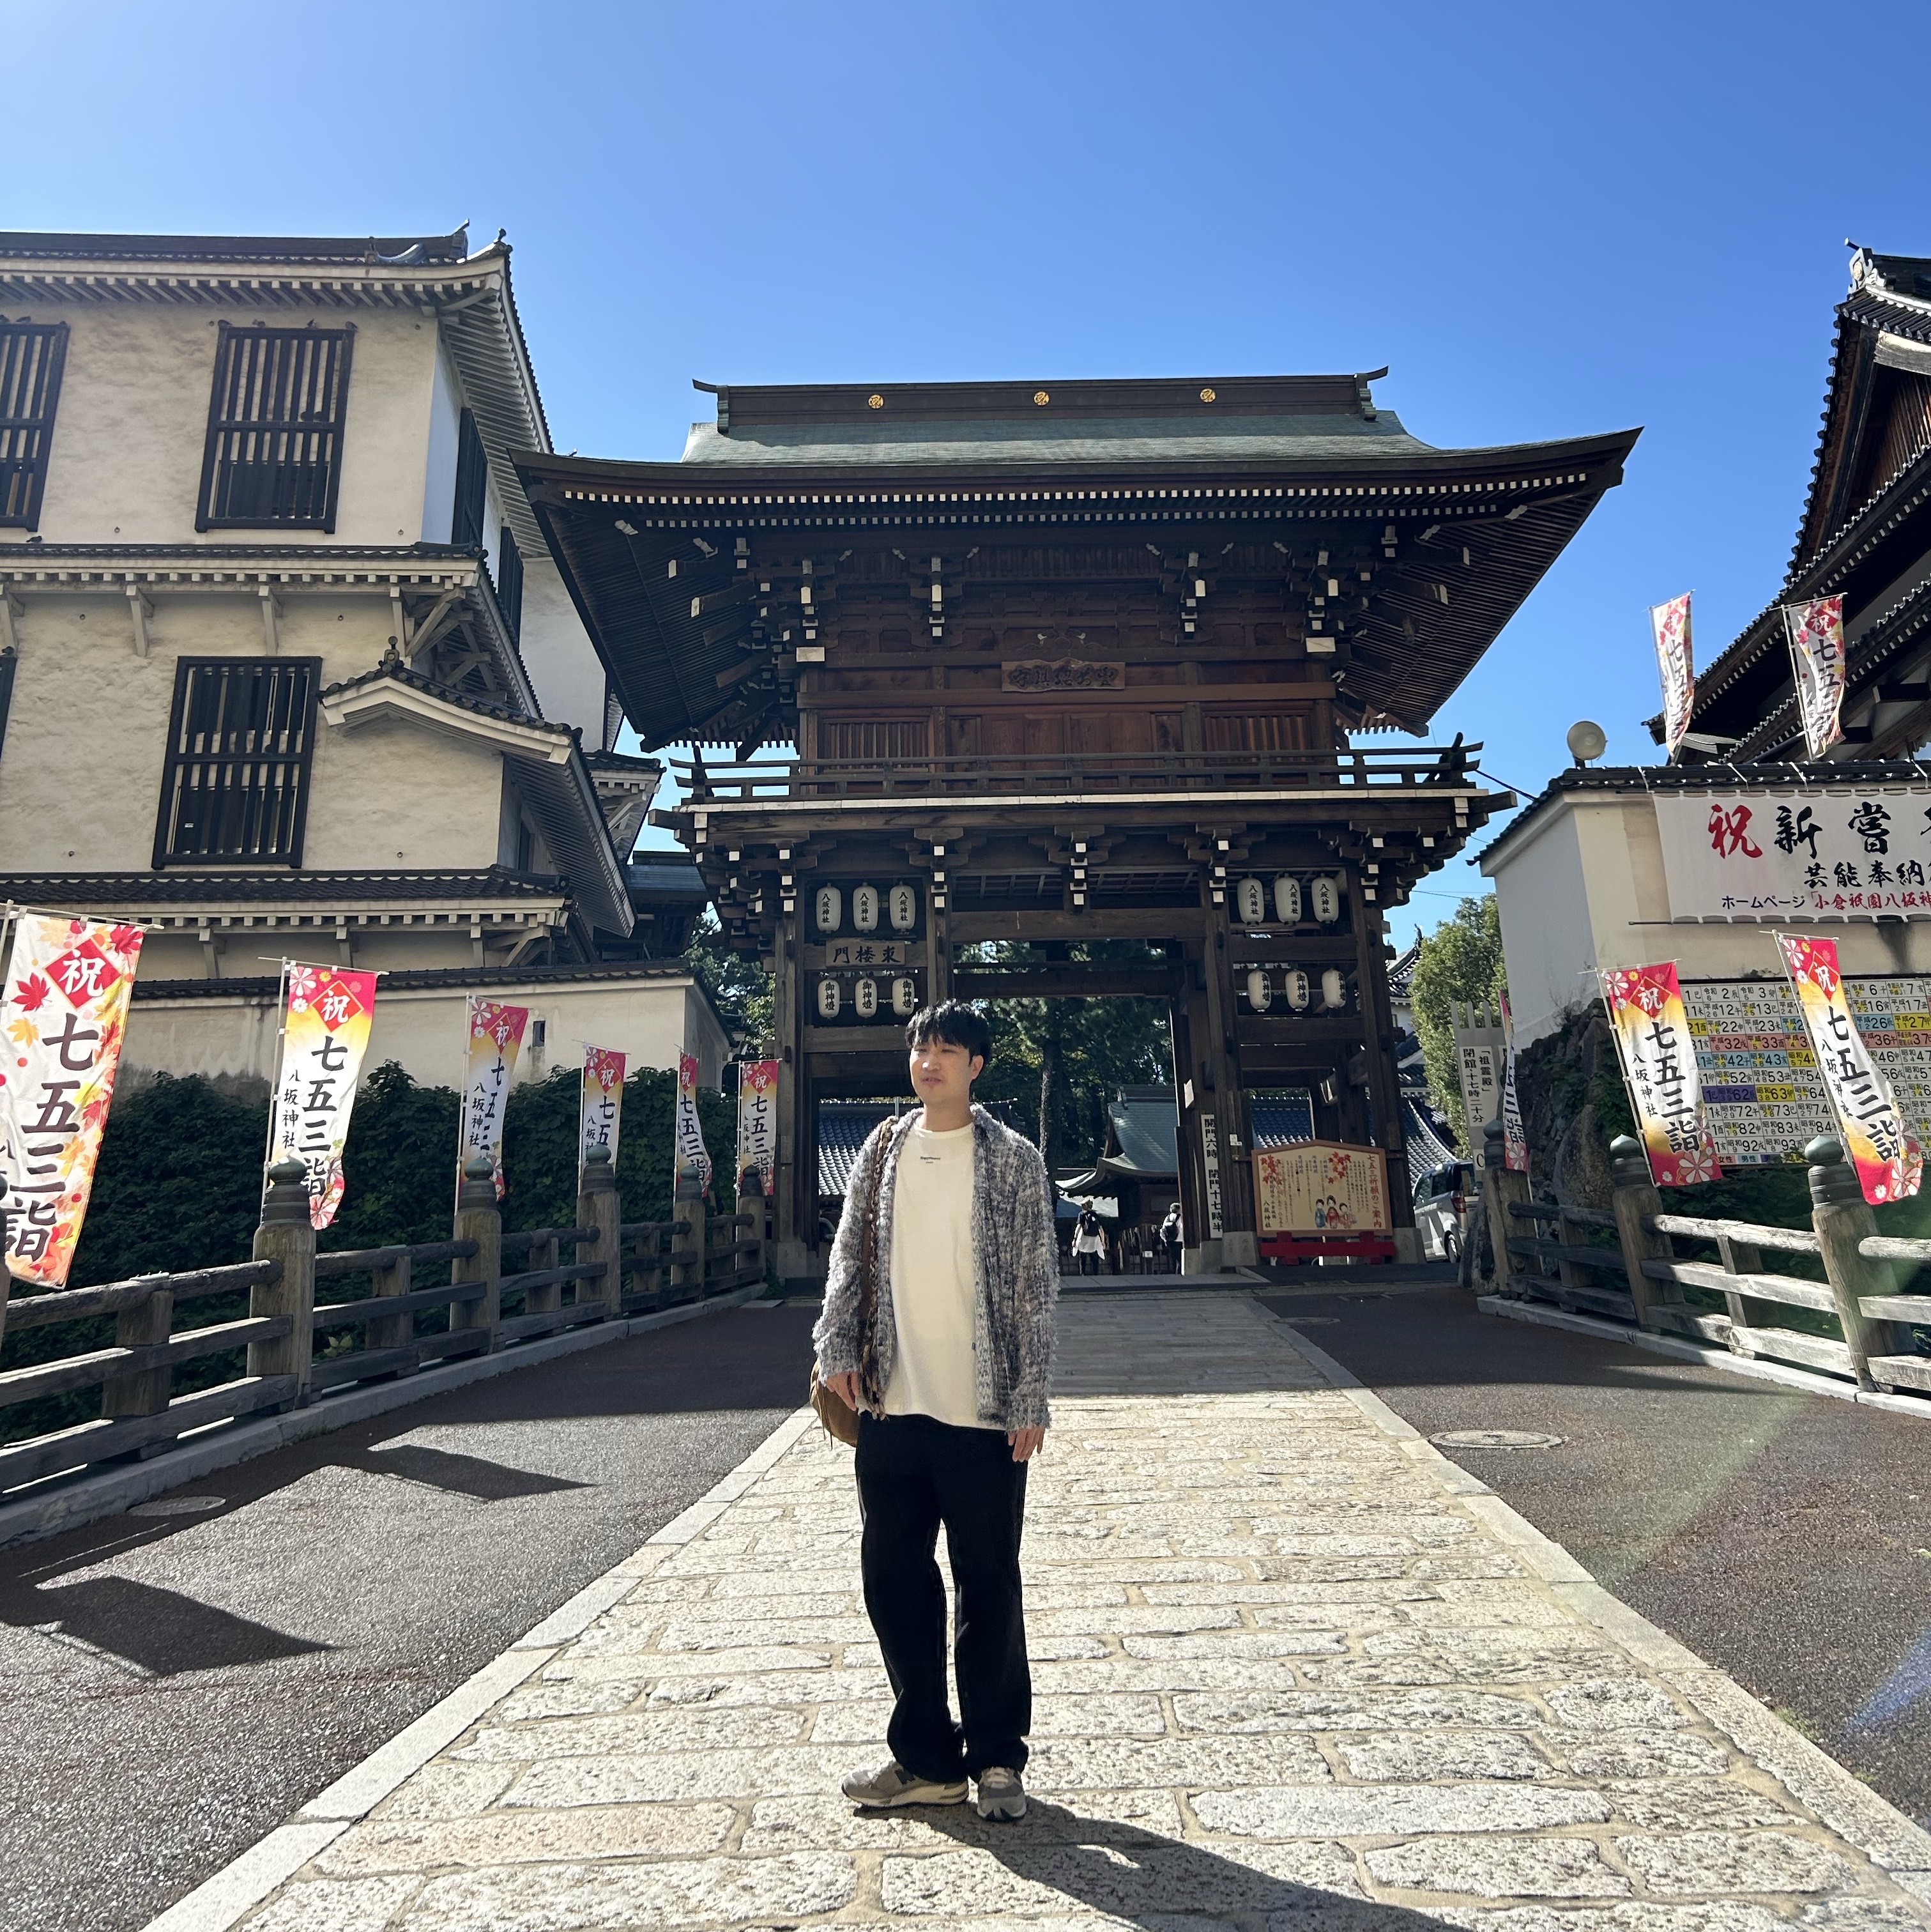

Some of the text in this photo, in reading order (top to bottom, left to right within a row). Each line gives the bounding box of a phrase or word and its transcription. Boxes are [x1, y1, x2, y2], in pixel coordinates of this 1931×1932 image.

[1811, 614, 1832, 632] 祝
[1805, 860, 1931, 889] 芸能奉納
[821, 893, 831, 923] 八坂神社
[859, 892, 870, 923] 八坂神社
[898, 891, 908, 921] 八坂神社
[1248, 885, 1260, 916] 八坂神社
[1289, 884, 1299, 915] 八坂神社
[1320, 883, 1331, 914] 八坂神社
[1722, 895, 1805, 910] ホームページ
[57, 951, 106, 997] 祝
[1813, 963, 1836, 993] 祝
[321, 990, 351, 1023] 祝
[1638, 986, 1663, 1012] 祝
[495, 1020, 510, 1046] 祝
[600, 1065, 615, 1087] 祝
[755, 1073, 767, 1089] 祝
[1632, 1054, 1659, 1117] 八坂神社
[1645, 1022, 1700, 1153] 七五三詣
[1827, 1005, 1900, 1162] 七五三詣
[282, 1069, 301, 1149] 八坂神社
[298, 1035, 348, 1197] 七五三詣
[469, 1082, 487, 1147] 八坂神社
[597, 1095, 616, 1147] 七五
[0, 1012, 100, 1262] 七五三詣
[751, 1095, 770, 1176] 七五三詣
